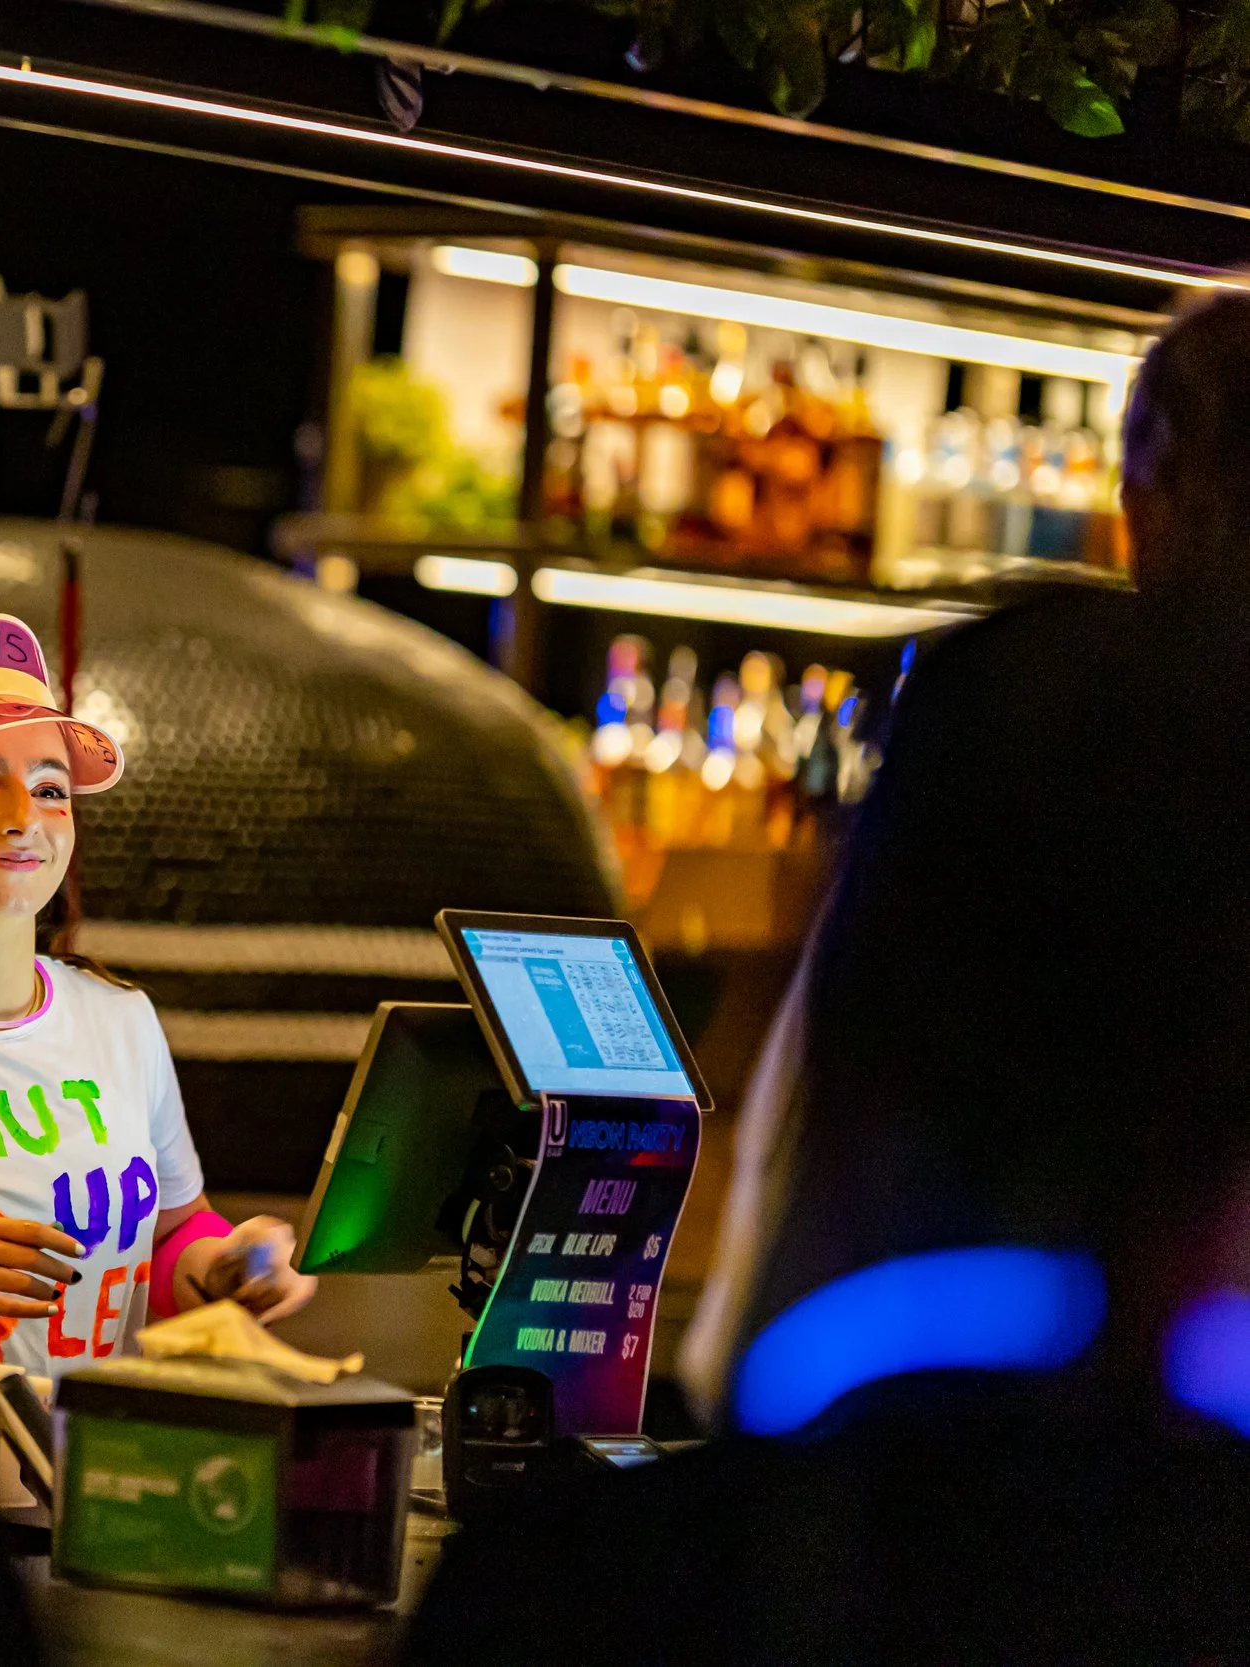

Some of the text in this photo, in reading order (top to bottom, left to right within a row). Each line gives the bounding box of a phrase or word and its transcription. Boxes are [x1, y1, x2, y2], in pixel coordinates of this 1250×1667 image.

[568, 1120, 685, 1152] NEON PARTY
[52, 1156, 158, 1260] UP
[578, 1179, 637, 1215] MENU
[562, 1233, 591, 1256] BLUE
[589, 1234, 617, 1256] LIPS
[643, 1234, 662, 1260] $5
[530, 1279, 652, 1304] VODKA REDBULL 2 FOR
[517, 1328, 639, 1360] VODKA & MIXER $7
